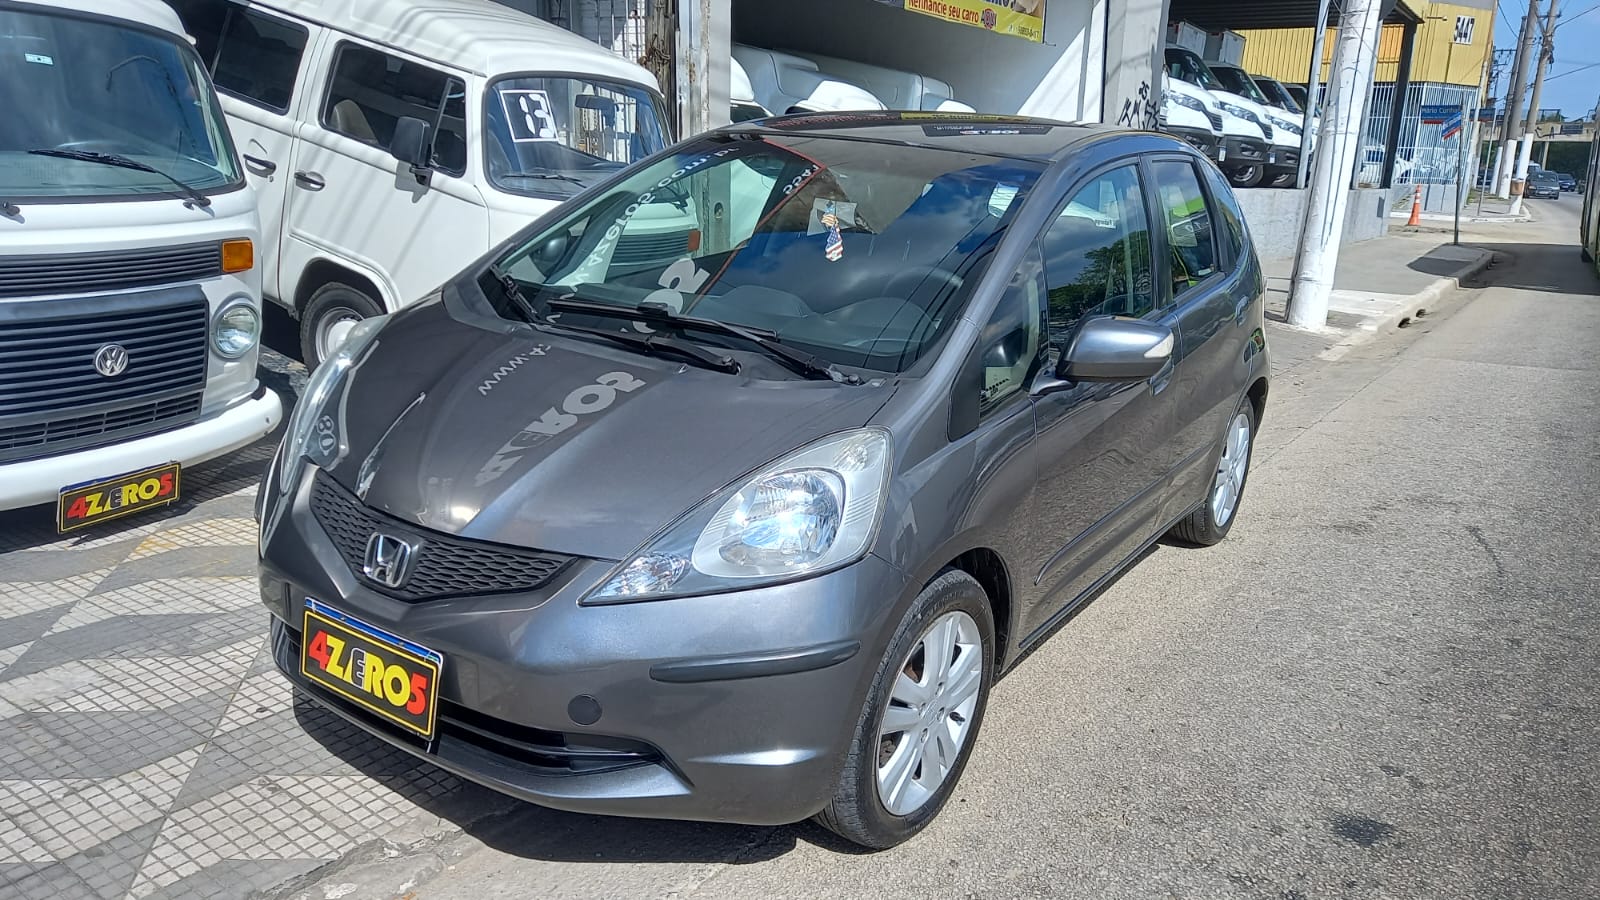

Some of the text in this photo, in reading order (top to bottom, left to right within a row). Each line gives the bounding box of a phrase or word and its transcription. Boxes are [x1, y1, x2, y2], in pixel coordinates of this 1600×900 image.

[948, 5, 960, 18] seu
[962, 9, 979, 23] carro
[1454, 17, 1475, 43] 5447
[519, 93, 556, 138] 13
